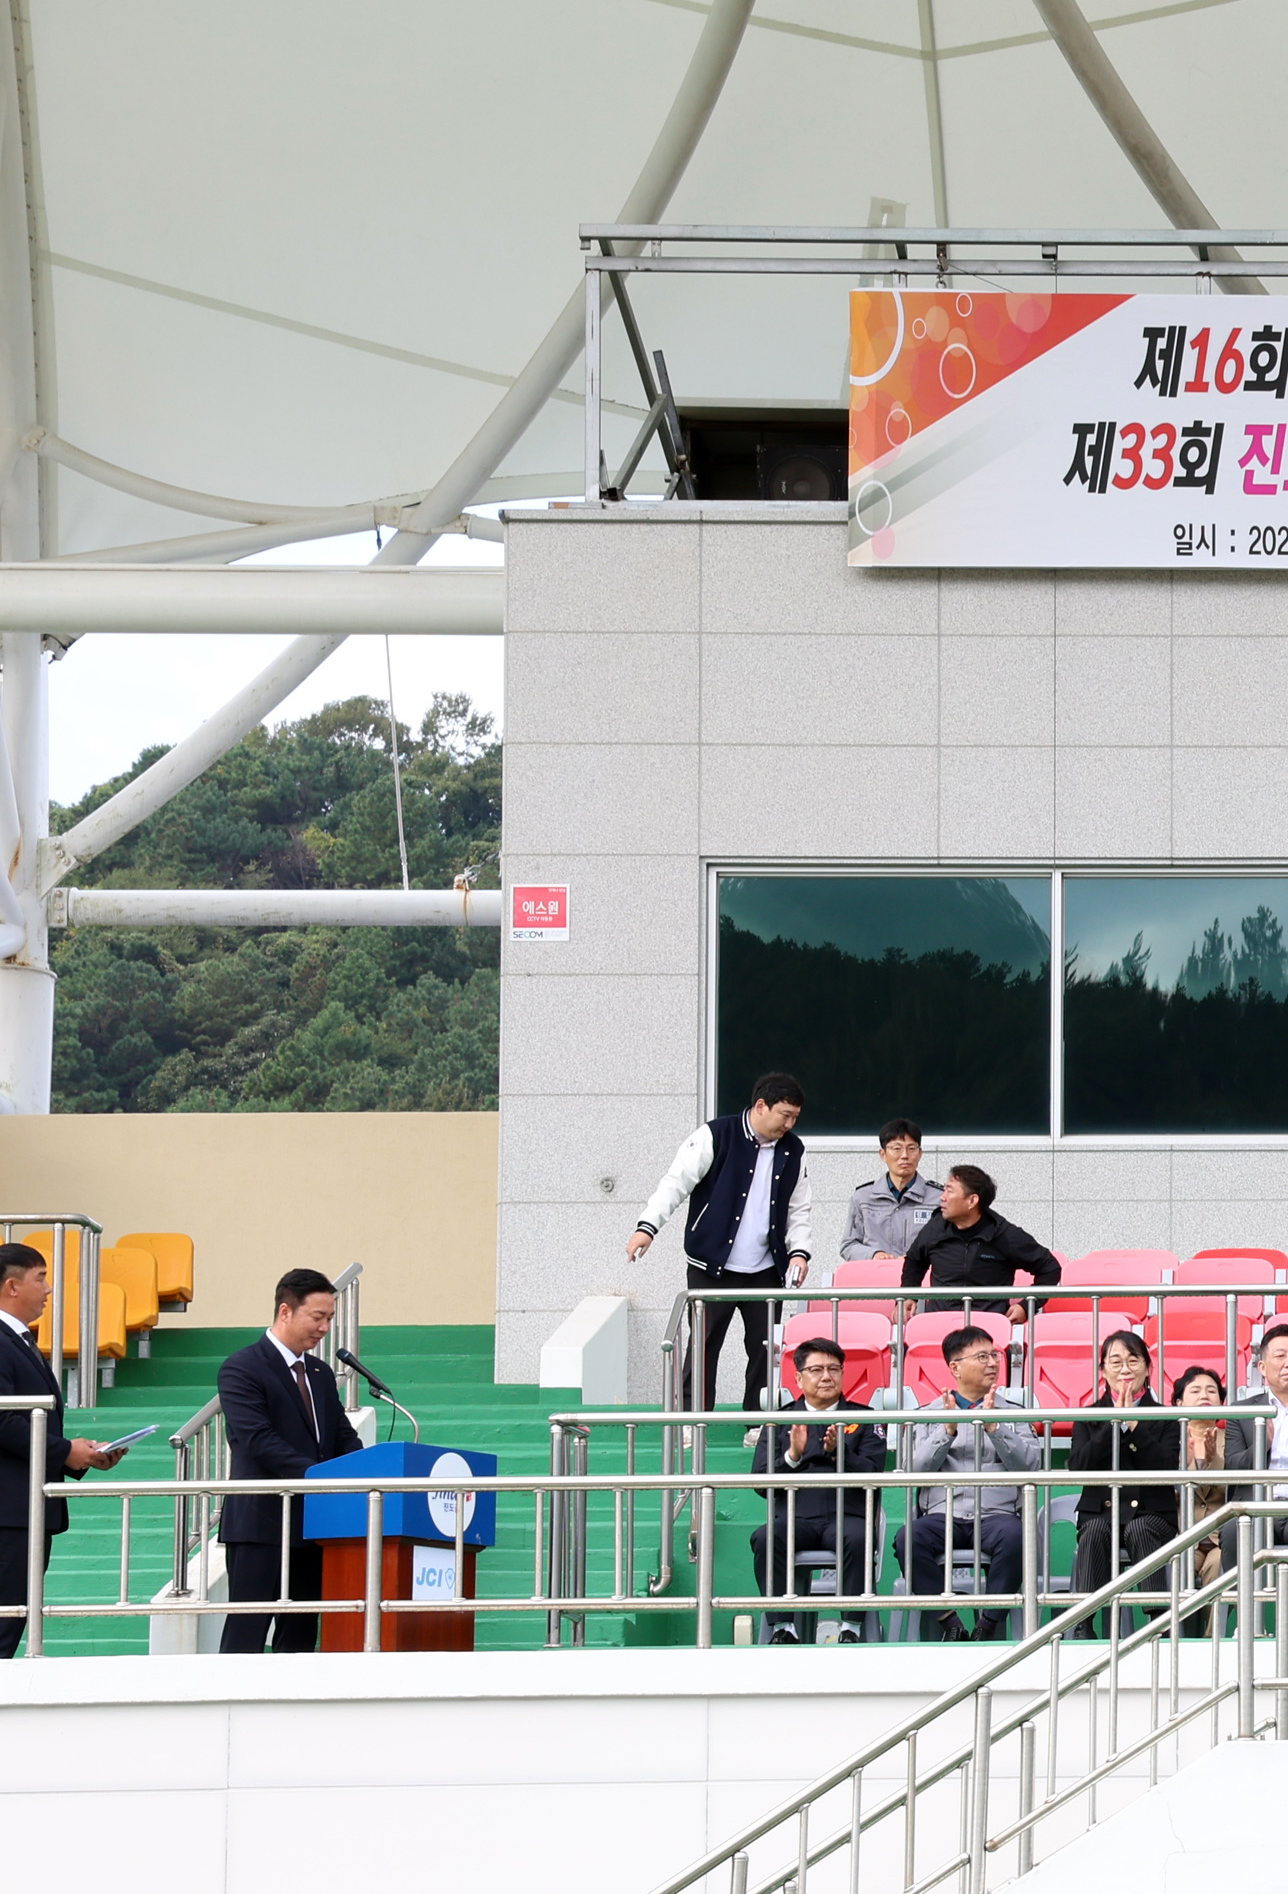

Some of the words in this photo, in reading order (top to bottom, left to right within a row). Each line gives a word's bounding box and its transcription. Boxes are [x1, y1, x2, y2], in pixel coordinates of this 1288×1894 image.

[1063, 420, 1224, 495] 제33회
[1174, 523, 1215, 556] 일시
[522, 901, 559, 915] 에스원
[443, 1503, 458, 1512] 진도
[416, 1567, 443, 1587] JCI
